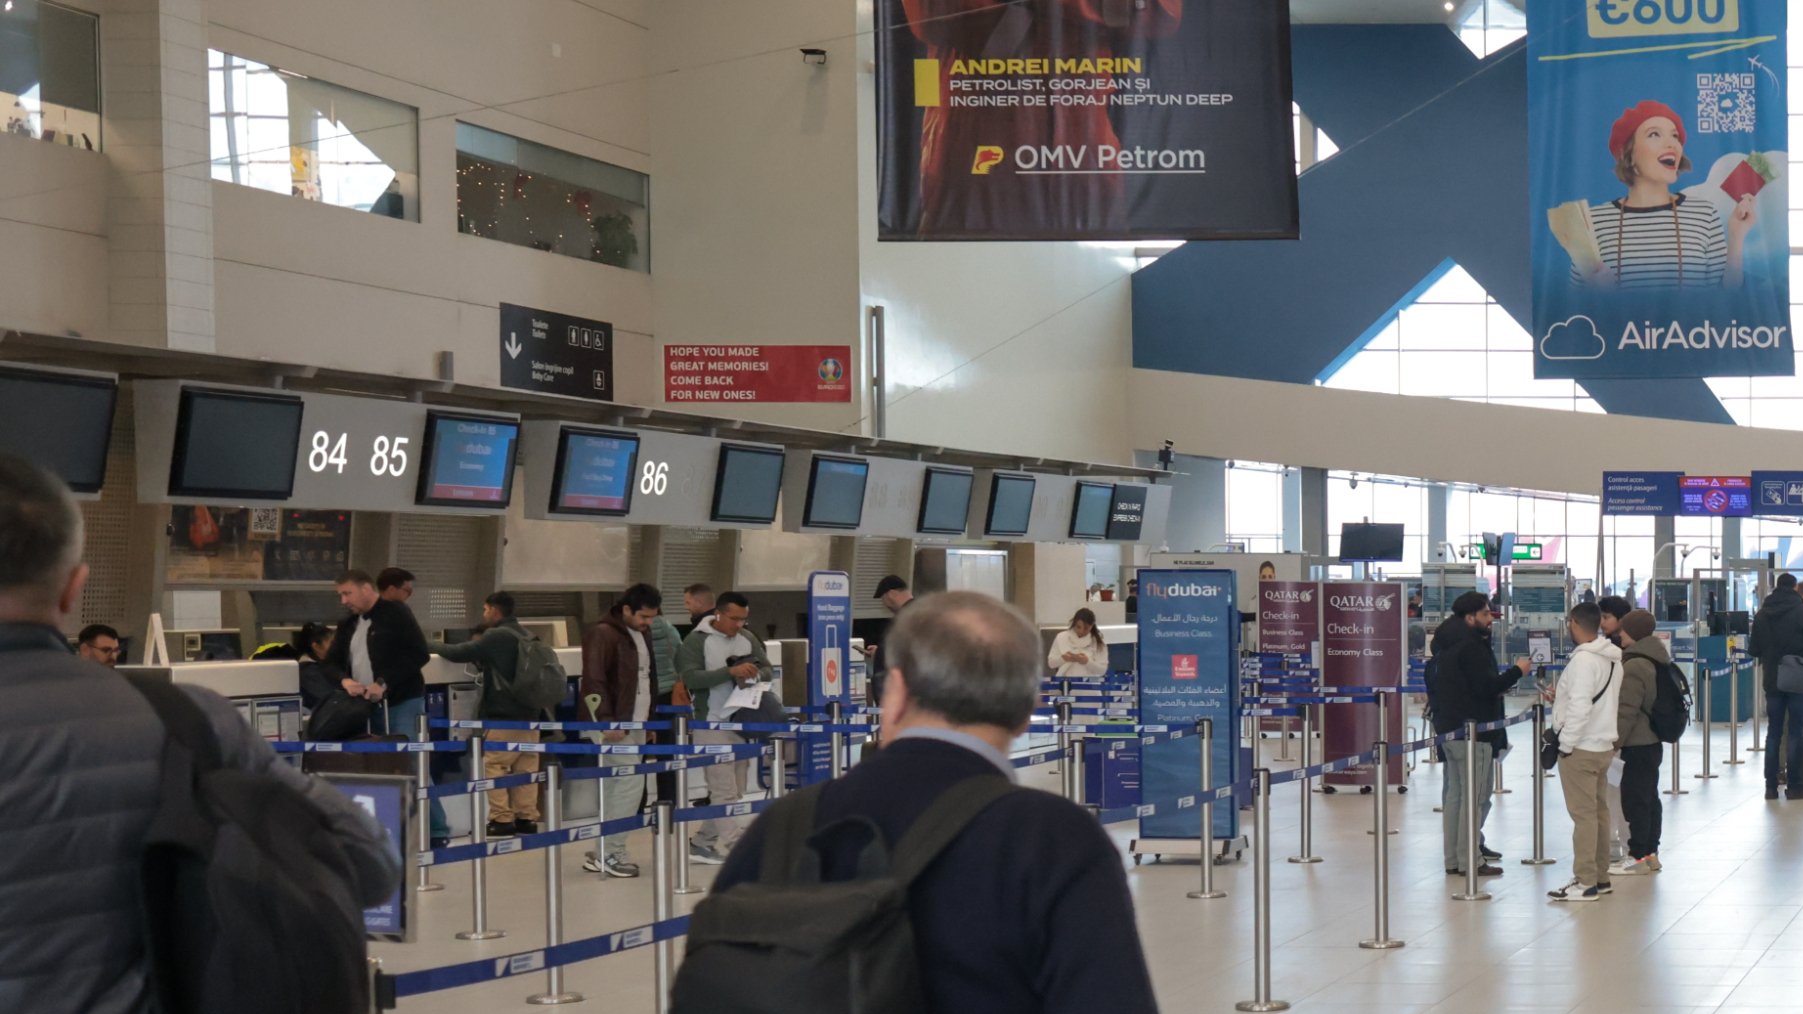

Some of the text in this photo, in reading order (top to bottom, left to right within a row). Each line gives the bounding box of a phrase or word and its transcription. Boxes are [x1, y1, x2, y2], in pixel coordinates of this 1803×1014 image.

[1595, 0, 1725, 25] €600
[949, 57, 1142, 75] ANDREI MARIN
[950, 79, 1046, 92] PETROLIST,
[1049, 78, 1131, 90] GORJEAN
[950, 94, 1233, 107] INGINER DE FORAJ NEPTUN DEEP
[1015, 145, 1206, 169] OMV Petrom
[1617, 319, 1787, 350] AirAdvisor
[670, 346, 760, 357] HOPE YOU MADE
[670, 361, 769, 372] GREAT MEMORIES!
[670, 375, 734, 386] COME BACK
[670, 390, 756, 401] FOR NEW ONES!
[308, 430, 348, 474] 84
[370, 435, 409, 477] 85
[640, 460, 669, 496] 86
[1633, 485, 1658, 493] pasageri
[1146, 582, 1222, 599] flydubai
[1264, 590, 1299, 600] QATAR
[1329, 595, 1374, 608] QATAR
[1262, 611, 1299, 620] Check-in
[1154, 629, 1212, 638] Business Class
[1327, 623, 1375, 634] Check-in
[1327, 648, 1383, 658] Economy Class
